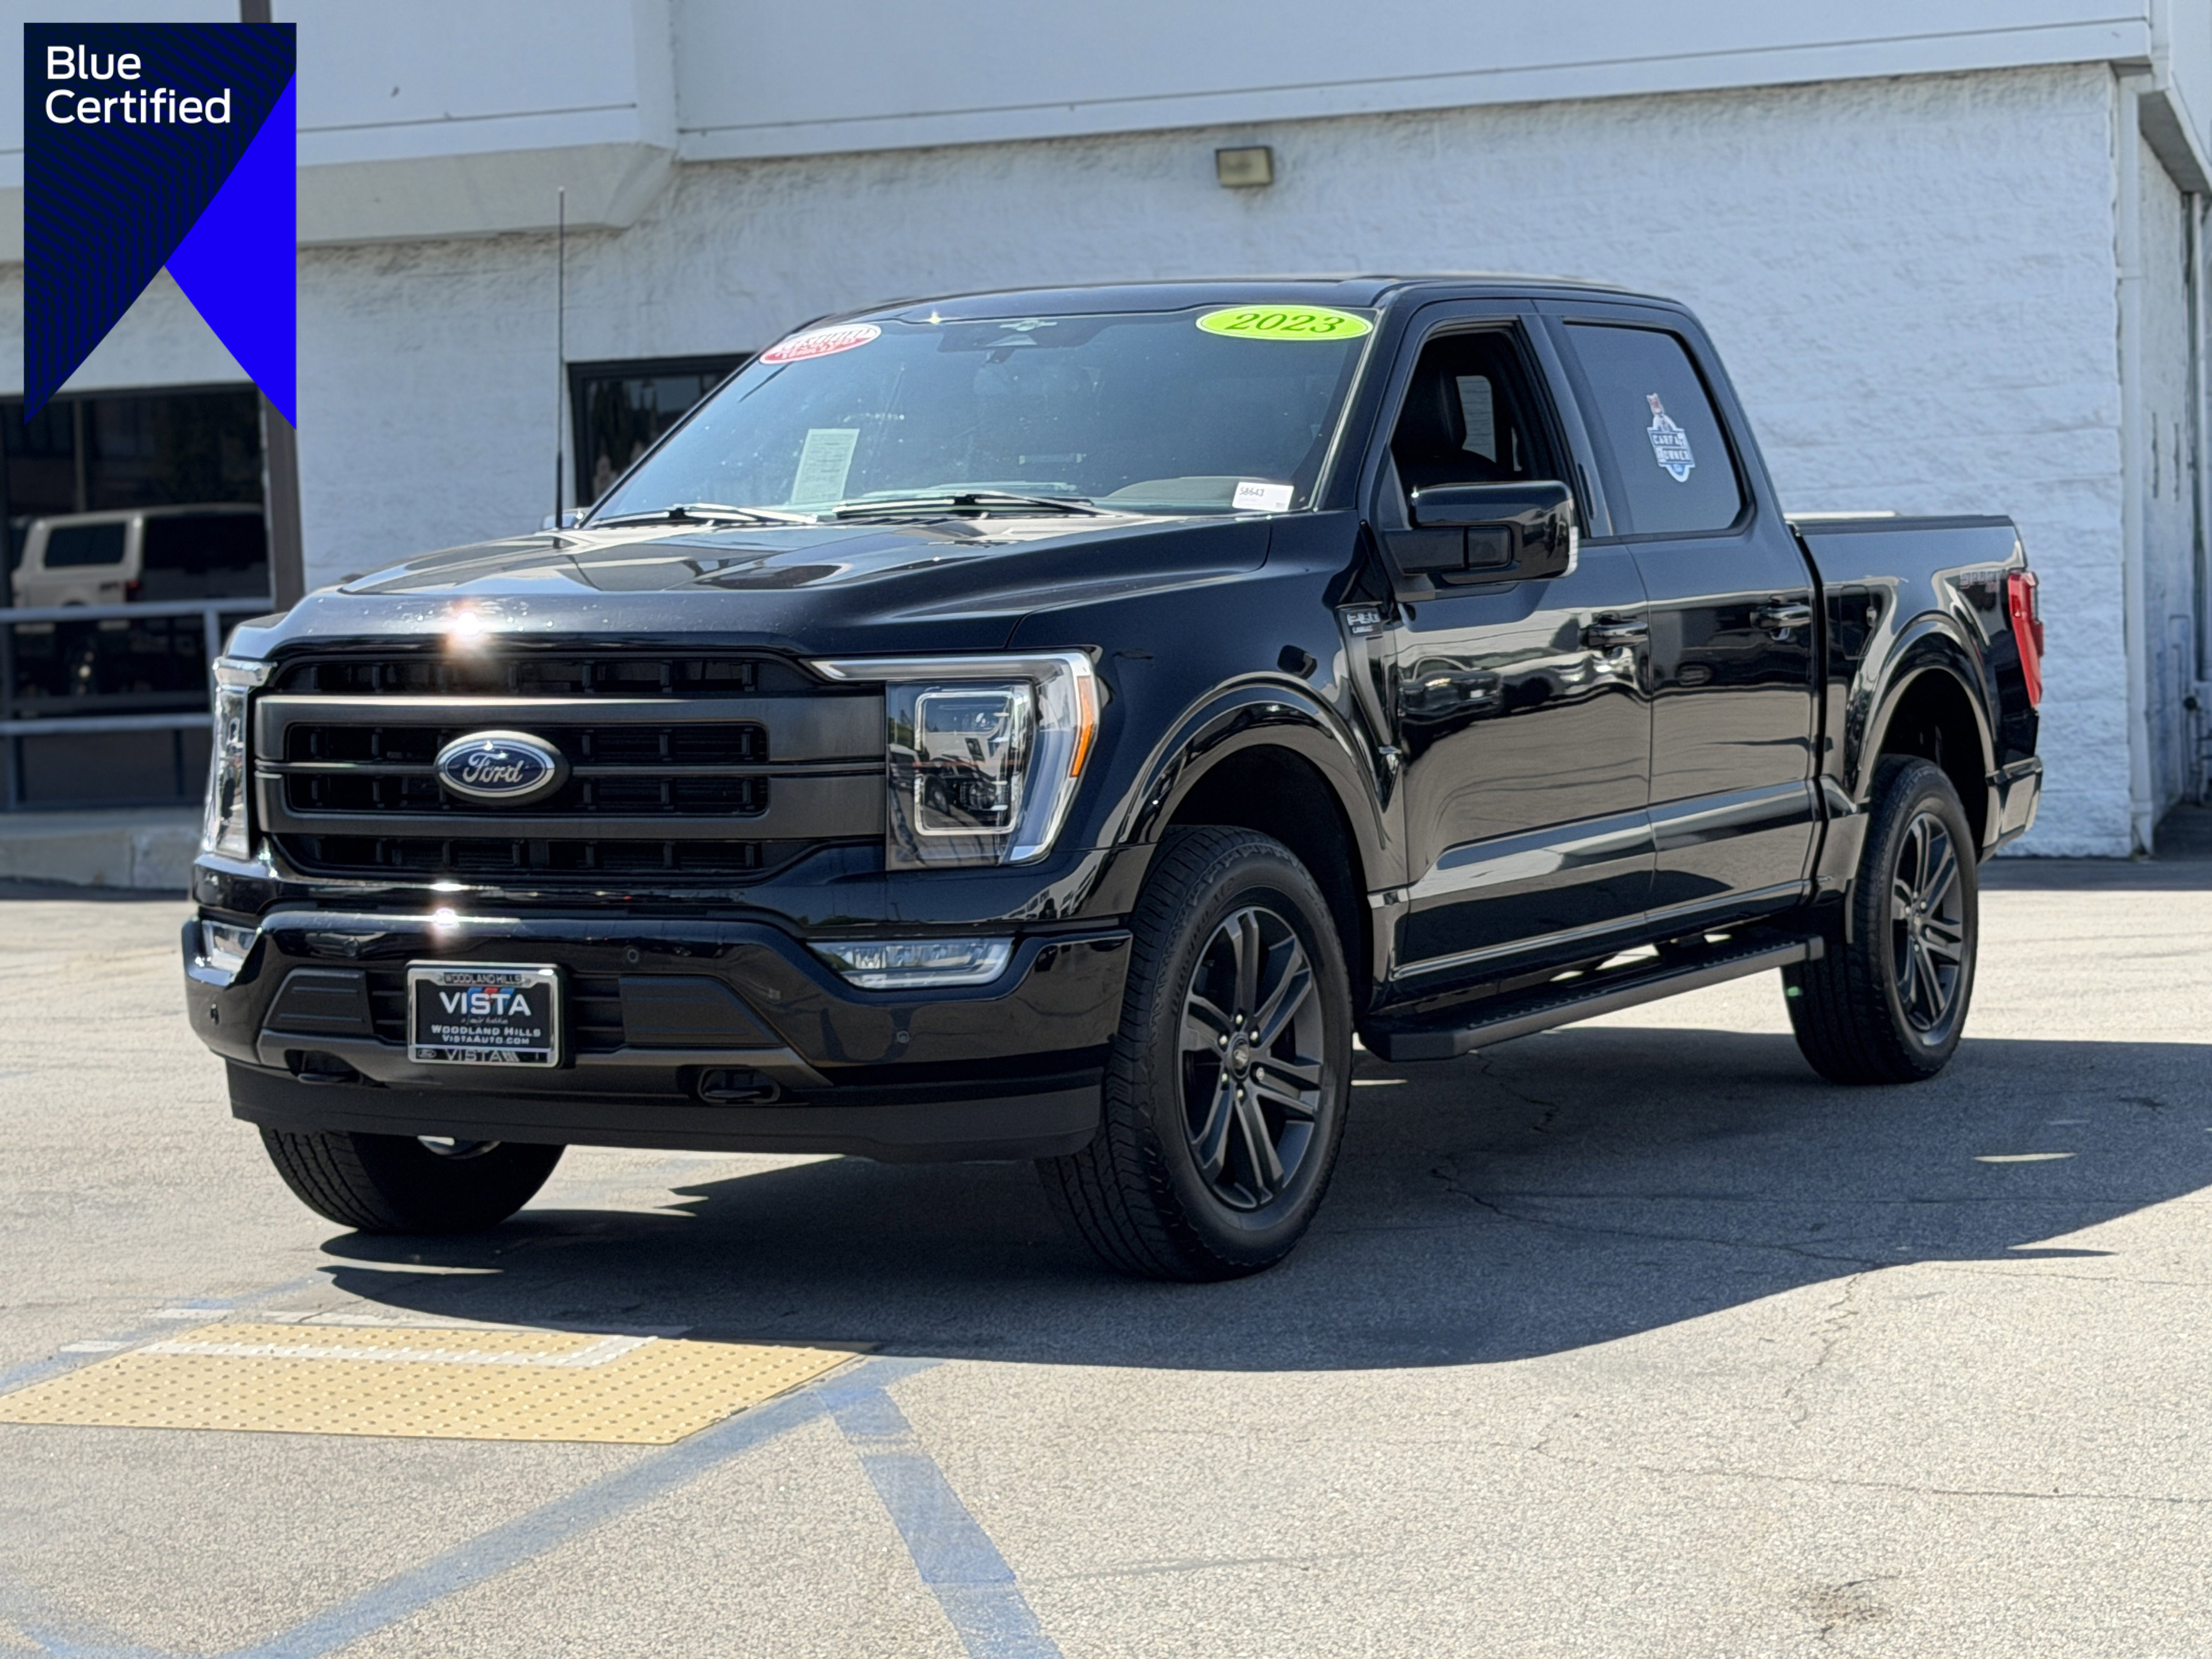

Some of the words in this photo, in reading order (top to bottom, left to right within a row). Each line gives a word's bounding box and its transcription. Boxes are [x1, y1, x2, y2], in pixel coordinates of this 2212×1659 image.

[1224, 313, 1345, 333] 2023
[462, 752, 524, 783] Ford
[439, 991, 532, 1016] VISTA
[431, 1025, 500, 1036] WOODLAND
[504, 1026, 541, 1037] HILLS
[445, 1048, 504, 1063] VISTA
